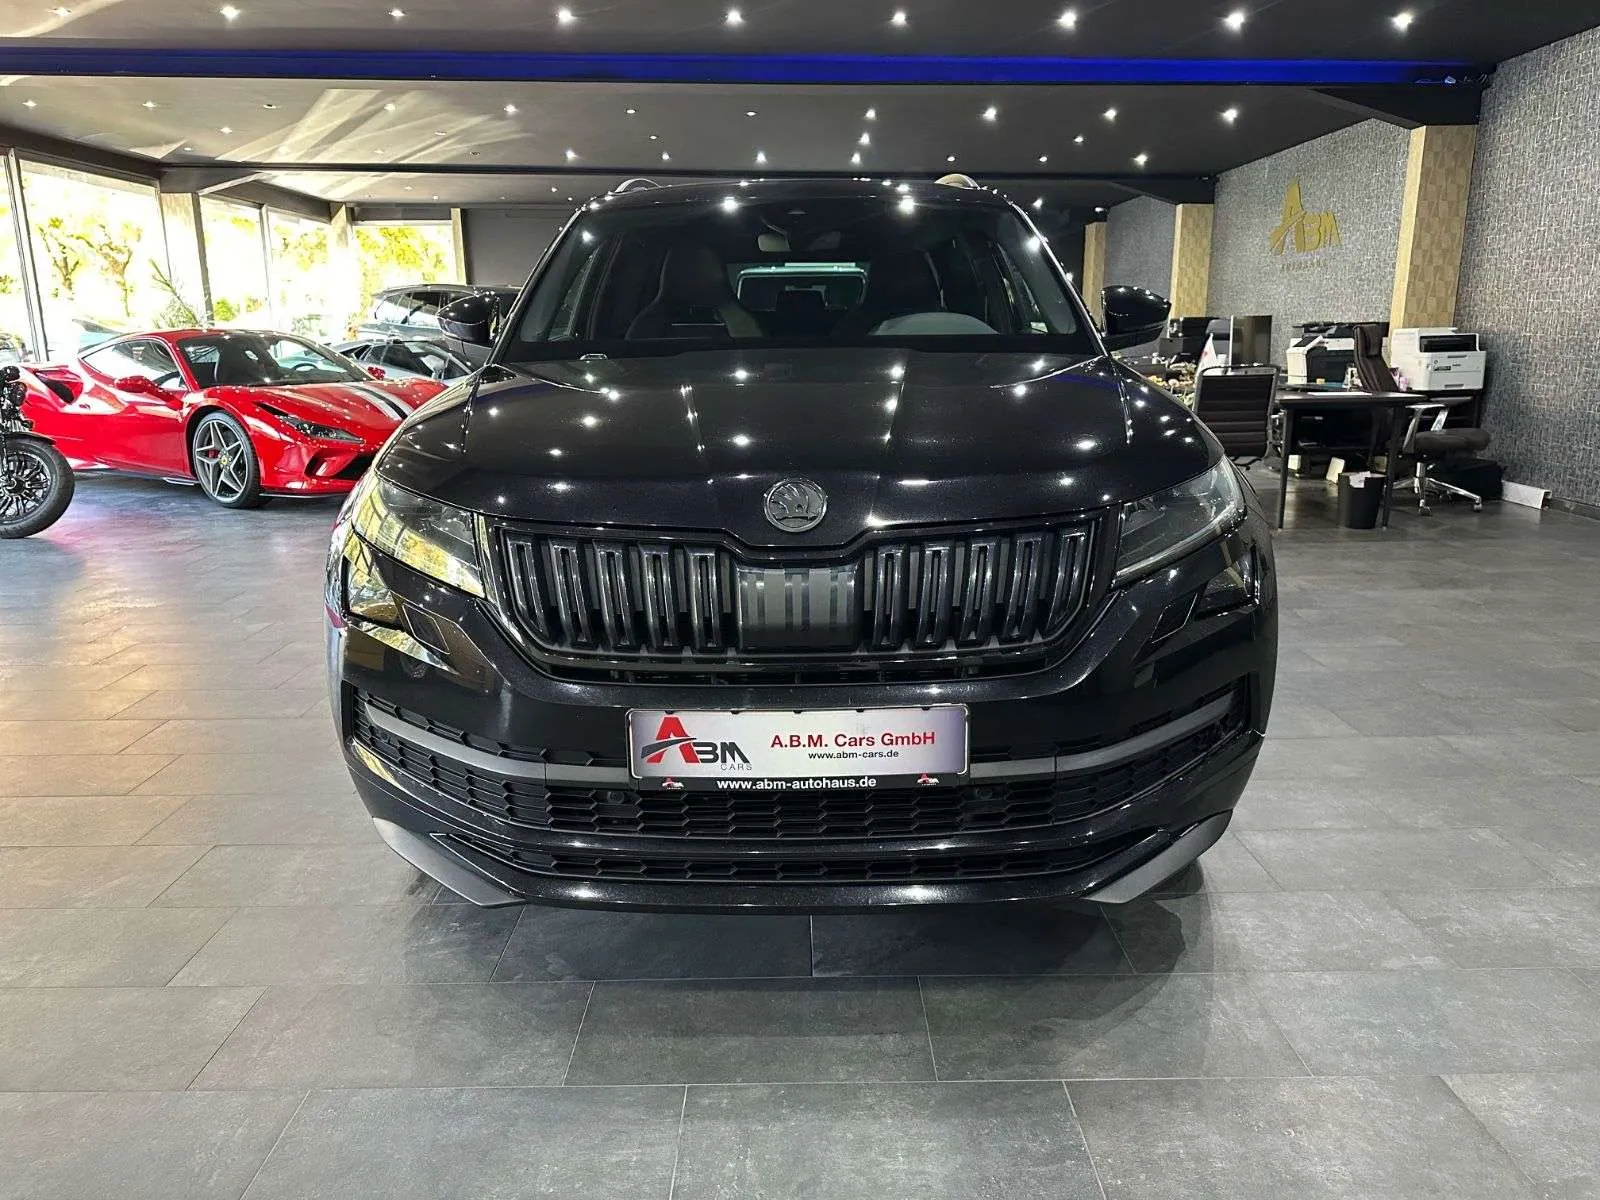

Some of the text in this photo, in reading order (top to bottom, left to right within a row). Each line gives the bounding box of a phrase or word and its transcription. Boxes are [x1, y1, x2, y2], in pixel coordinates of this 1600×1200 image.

[1268, 175, 1341, 256] ABM
[641, 716, 751, 764] ABM
[770, 731, 936, 748] A.B.M. Cars GmbH
[808, 749, 899, 759] www.abm-cars.de
[720, 763, 753, 771] CARS
[717, 776, 877, 790] www.abm-autohaus.de
